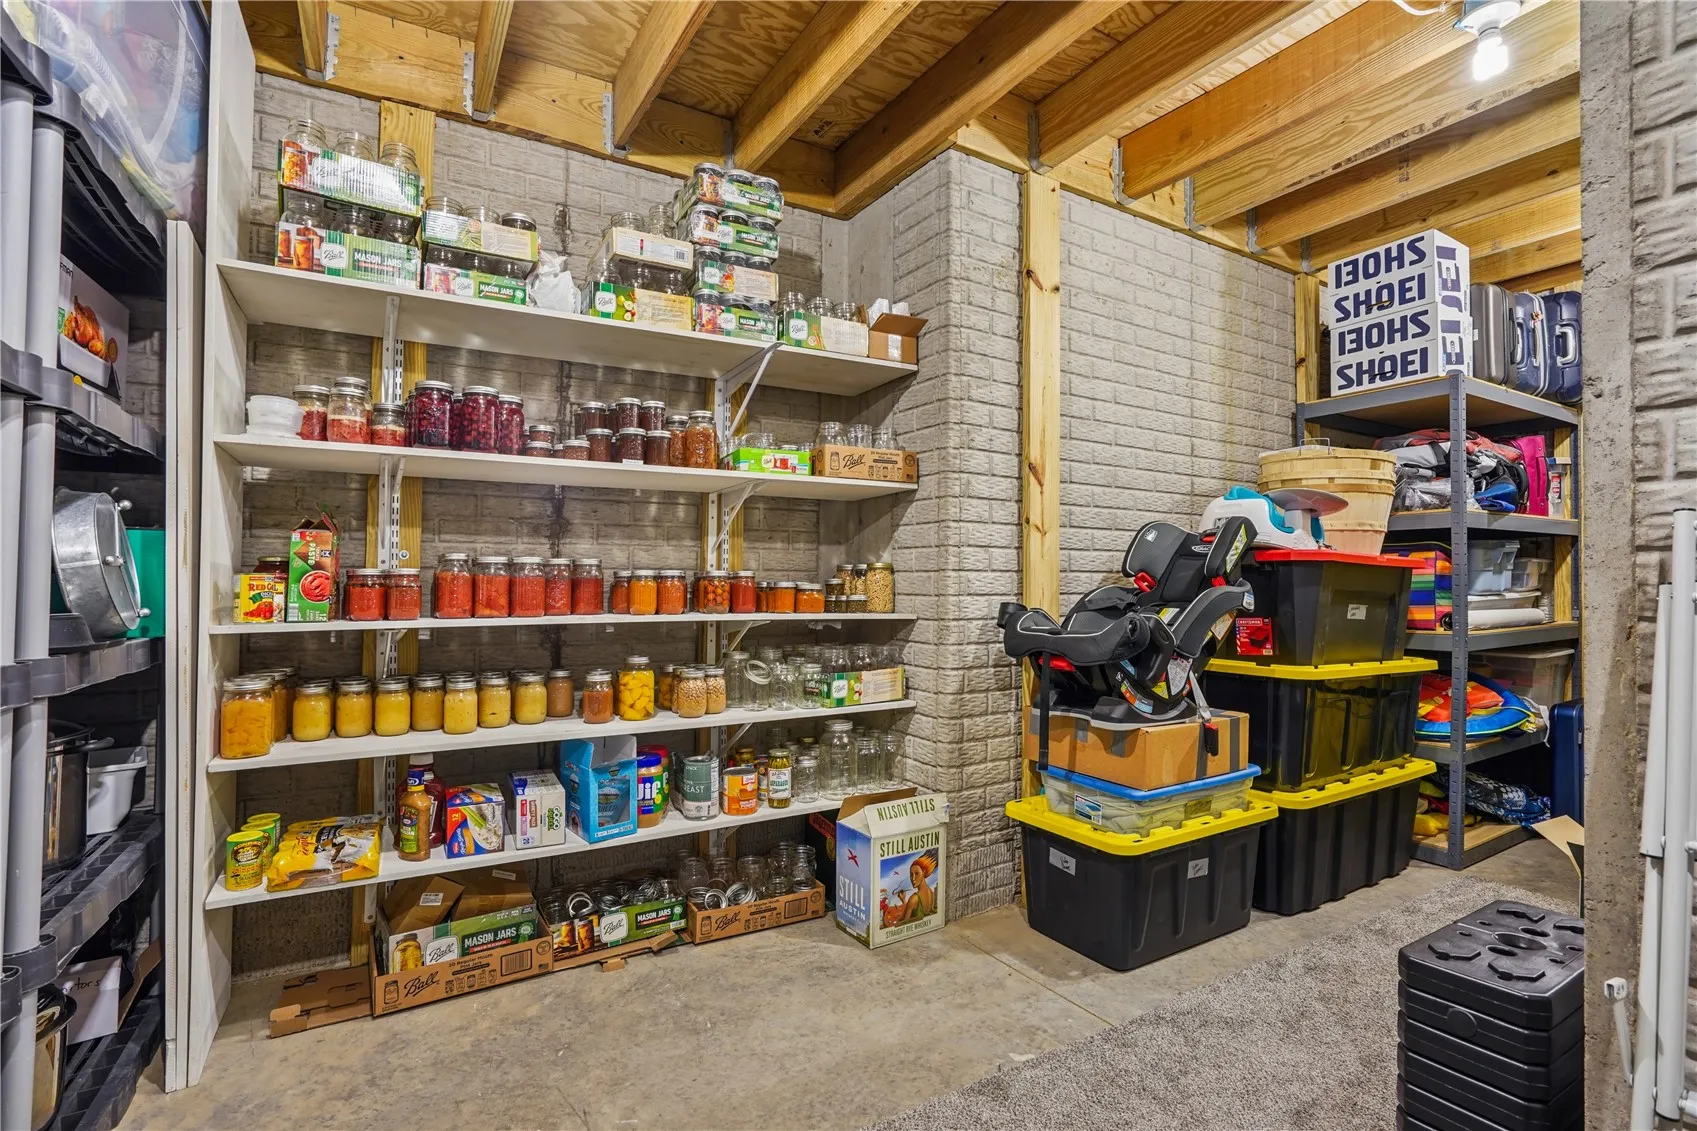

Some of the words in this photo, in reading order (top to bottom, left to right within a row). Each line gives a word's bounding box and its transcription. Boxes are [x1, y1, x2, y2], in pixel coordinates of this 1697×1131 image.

[323, 249, 345, 260] Ball
[354, 250, 380, 264] MASON
[382, 256, 403, 268] JARS
[1335, 235, 1427, 289] SHOEI
[480, 283, 499, 294] MASON
[499, 287, 514, 296] JARS
[1334, 272, 1426, 324] SHOEI
[1338, 309, 1431, 357] SHOEI
[1336, 346, 1429, 391] SHOEI
[843, 453, 866, 470] Ball
[308, 542, 316, 565] PASTE
[248, 583, 266, 591] RED
[319, 613, 327, 621] 12
[637, 781, 661, 800] Jif
[877, 803, 908, 821] AUSTIN
[909, 798, 936, 815] STILL
[452, 813, 459, 821] 12
[879, 839, 906, 858] STILL
[908, 831, 940, 851] AUSTIN
[839, 875, 865, 910] STILL
[637, 911, 657, 922] MASON
[657, 908, 671, 918] JARS
[840, 900, 866, 920] AUSTIN
[603, 919, 624, 935] Ball
[715, 911, 741, 932] Ball
[885, 926, 906, 939] STRAIGHT
[905, 924, 914, 934] RYE
[914, 919, 932, 930] WHISKEY
[464, 933, 494, 949] MASON
[496, 928, 517, 941] JARS
[428, 943, 455, 963] Ball
[404, 971, 440, 997] Ball
